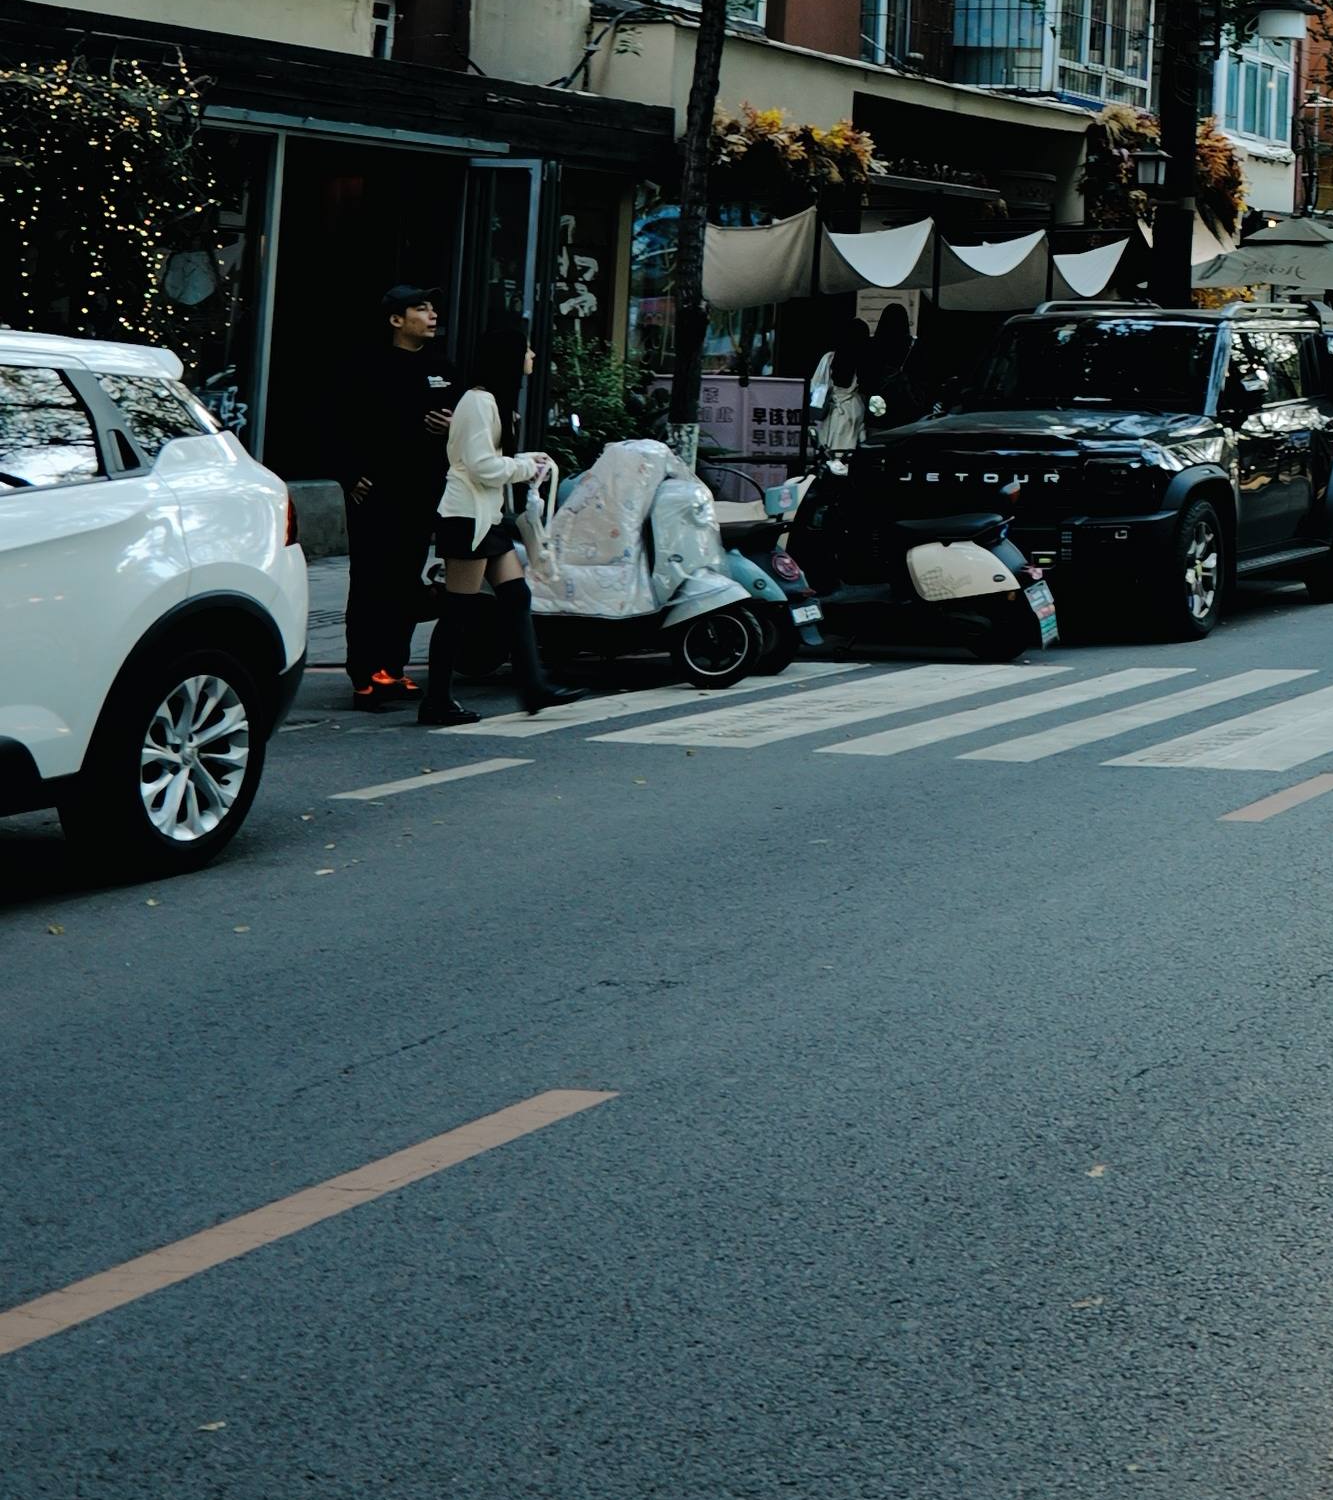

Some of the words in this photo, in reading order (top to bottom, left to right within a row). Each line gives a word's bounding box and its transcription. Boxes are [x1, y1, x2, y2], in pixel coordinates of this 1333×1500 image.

[752, 408, 805, 426] 早该如
[752, 430, 802, 447] 早该如
[899, 472, 1060, 484] JETOUR
